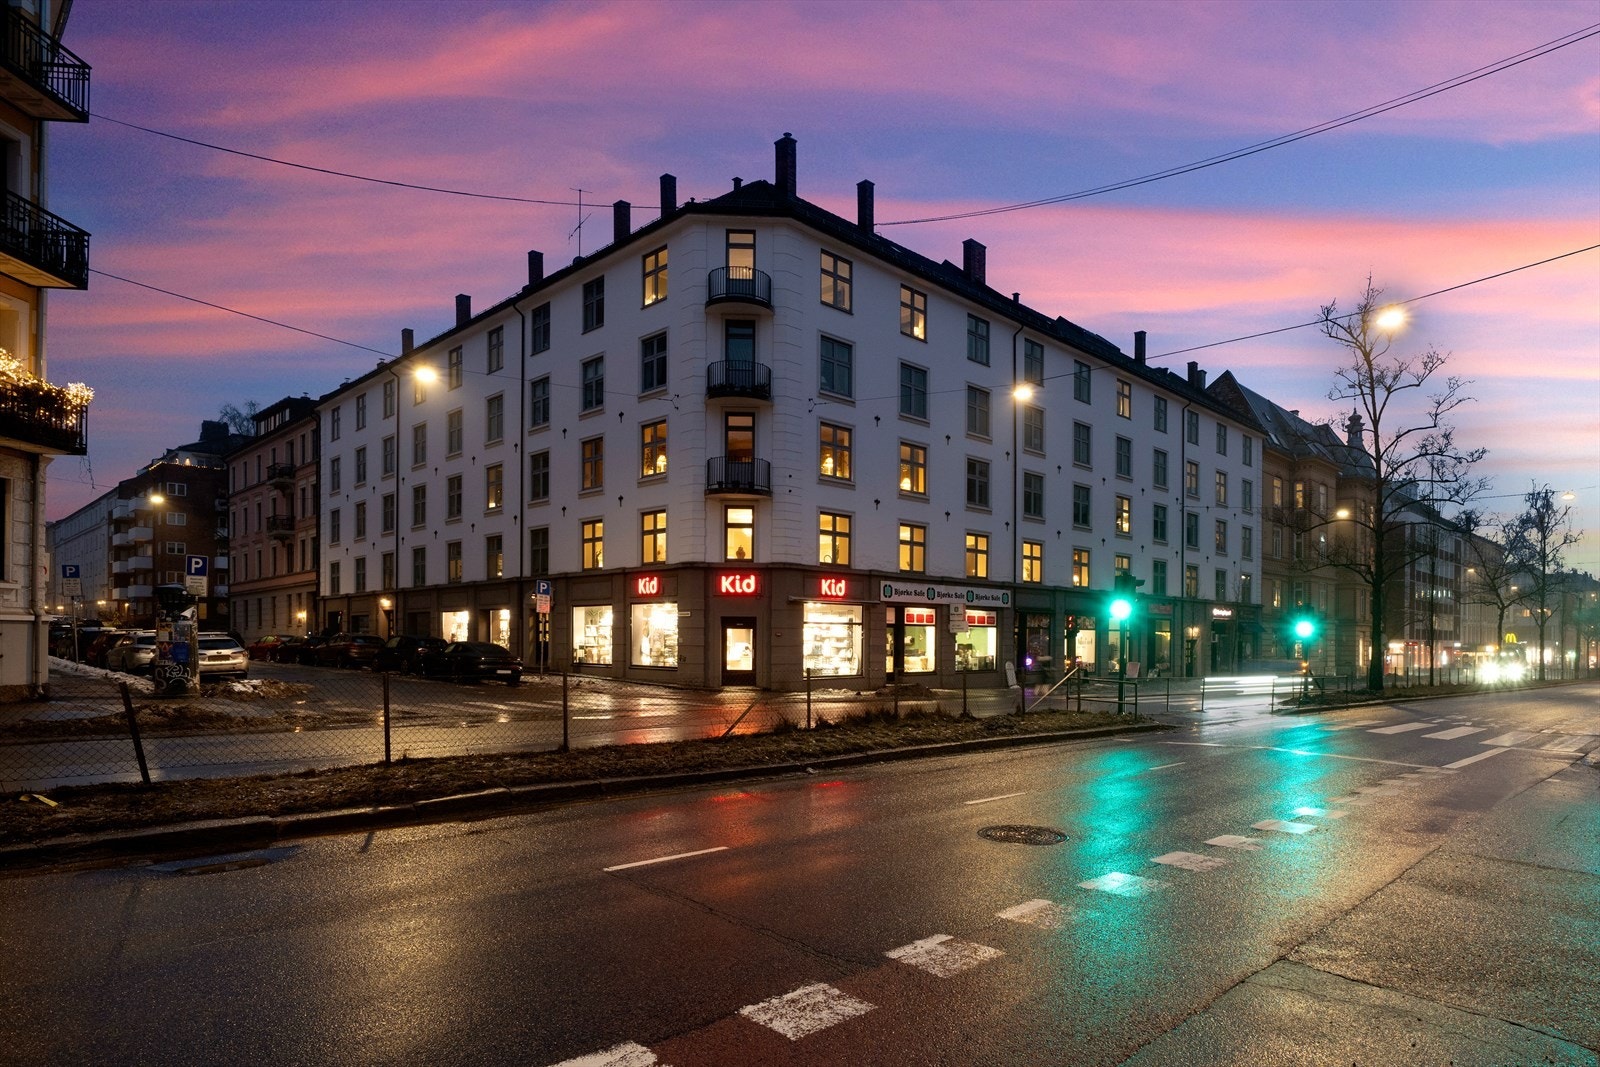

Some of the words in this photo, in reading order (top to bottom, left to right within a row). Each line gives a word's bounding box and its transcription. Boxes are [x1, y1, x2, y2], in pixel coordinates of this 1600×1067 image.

[66, 566, 76, 576] P
[191, 558, 203, 574] P
[540, 582, 548, 593] P
[638, 577, 658, 595] Kid
[721, 574, 756, 594] Kid
[821, 579, 846, 597] Kid
